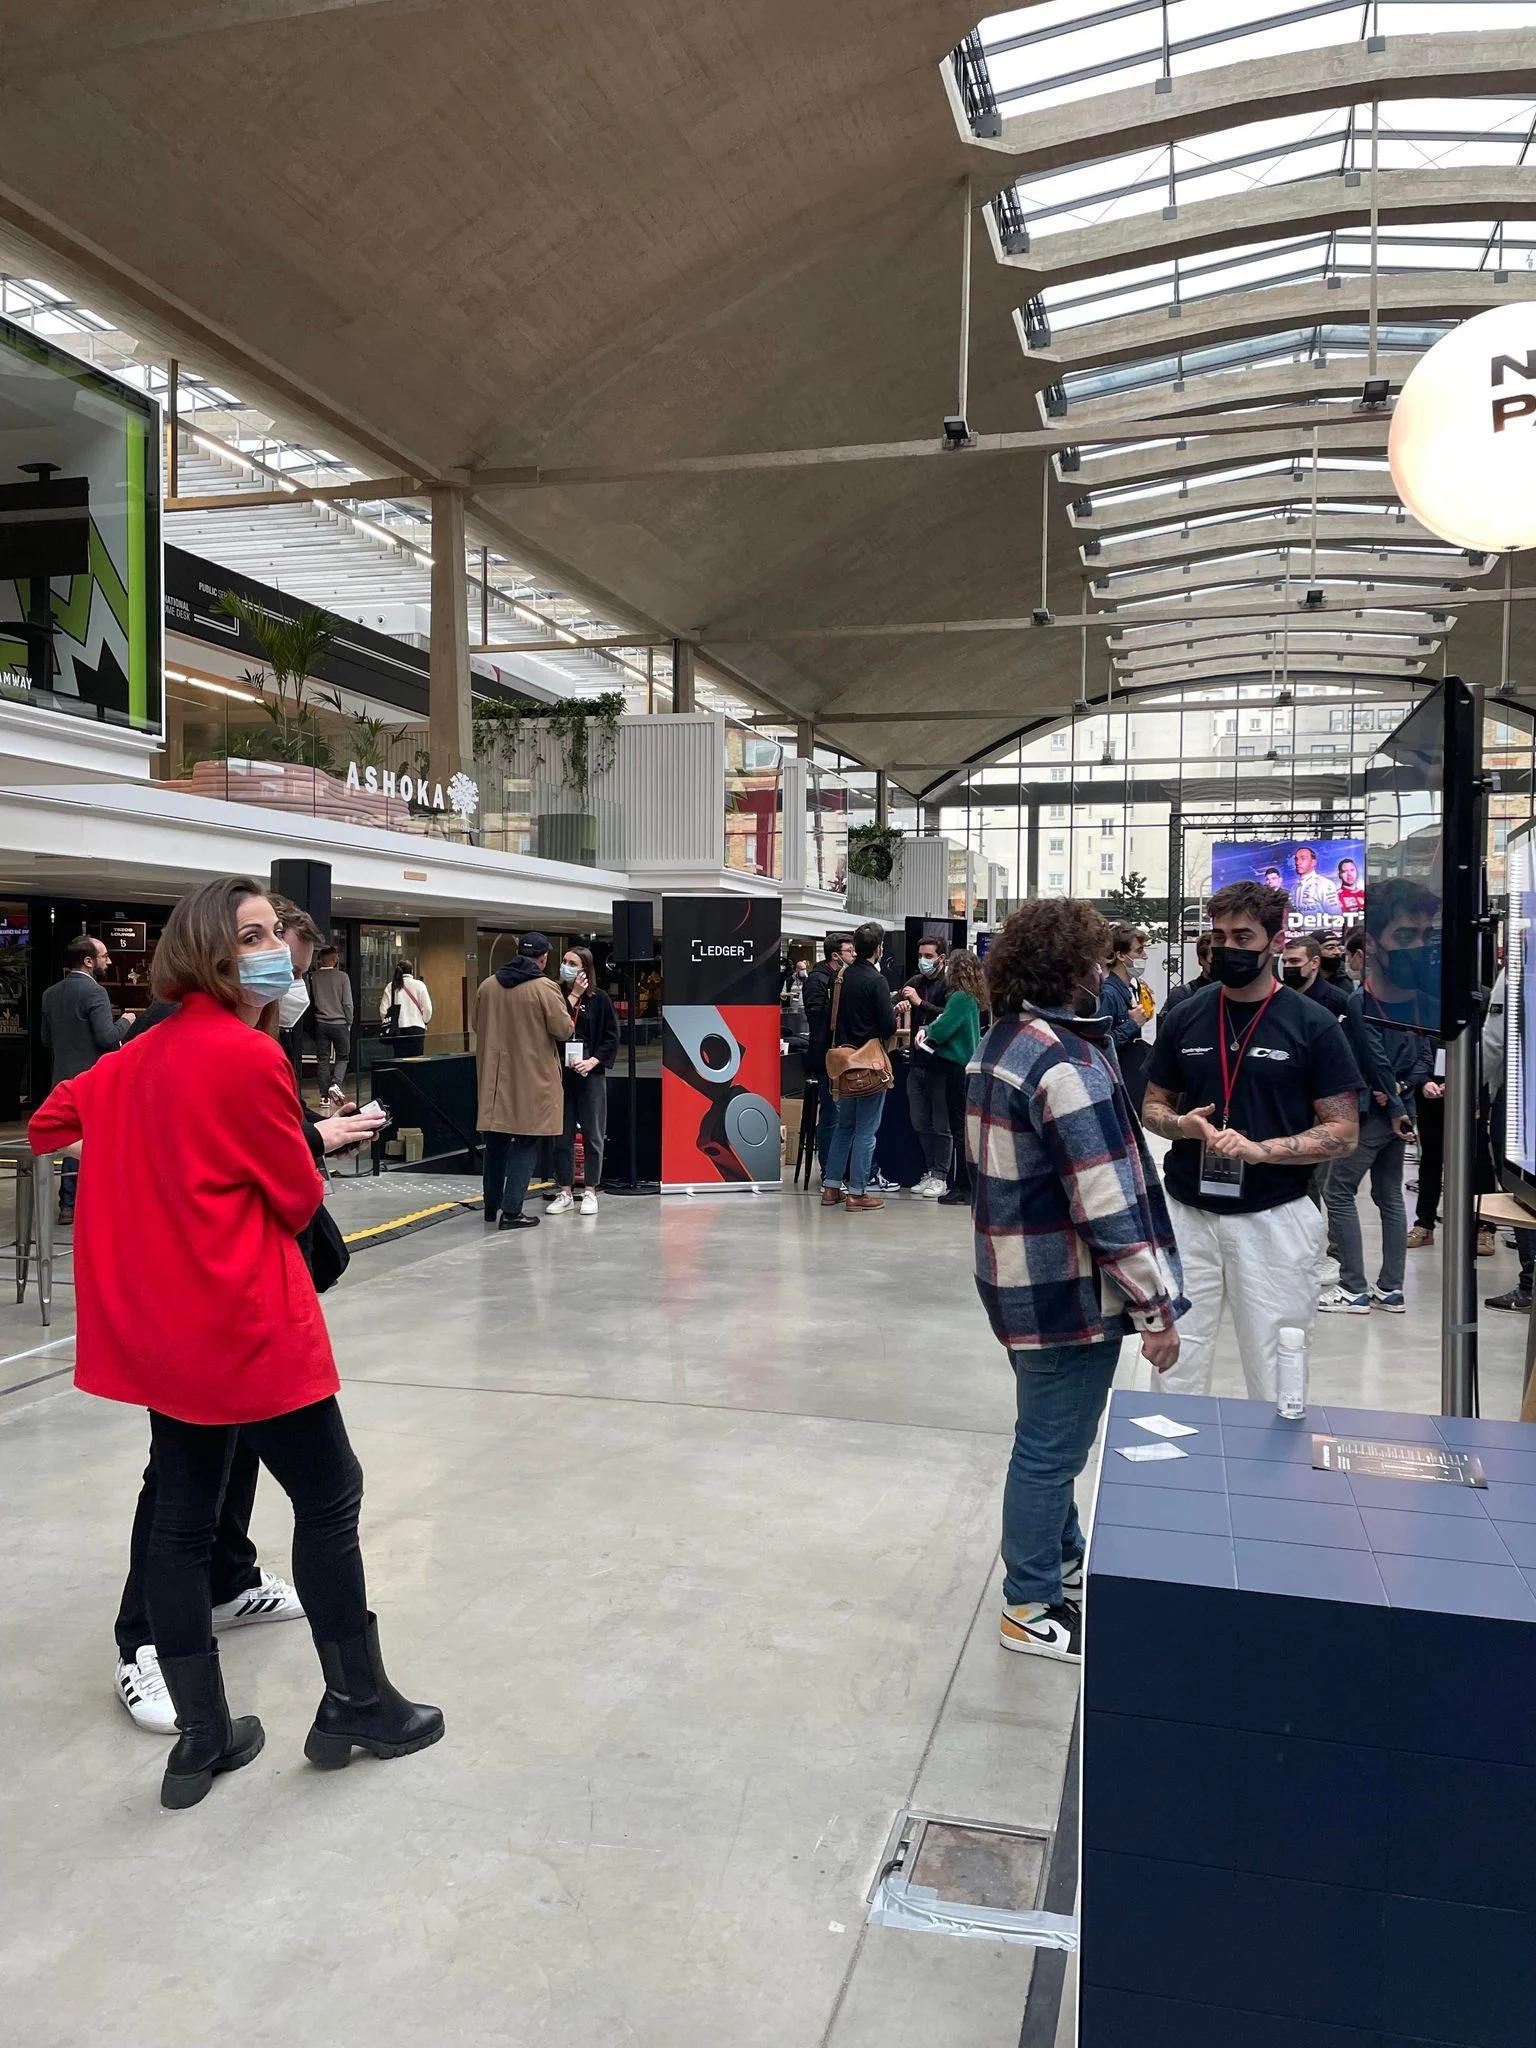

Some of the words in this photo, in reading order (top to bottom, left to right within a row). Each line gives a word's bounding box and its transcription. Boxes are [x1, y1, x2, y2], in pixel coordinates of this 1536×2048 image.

[198, 581, 218, 597] PUBLIC
[176, 608, 191, 621] DESK
[346, 761, 445, 810] ASHOKA
[700, 945, 745, 956] LEDGER
